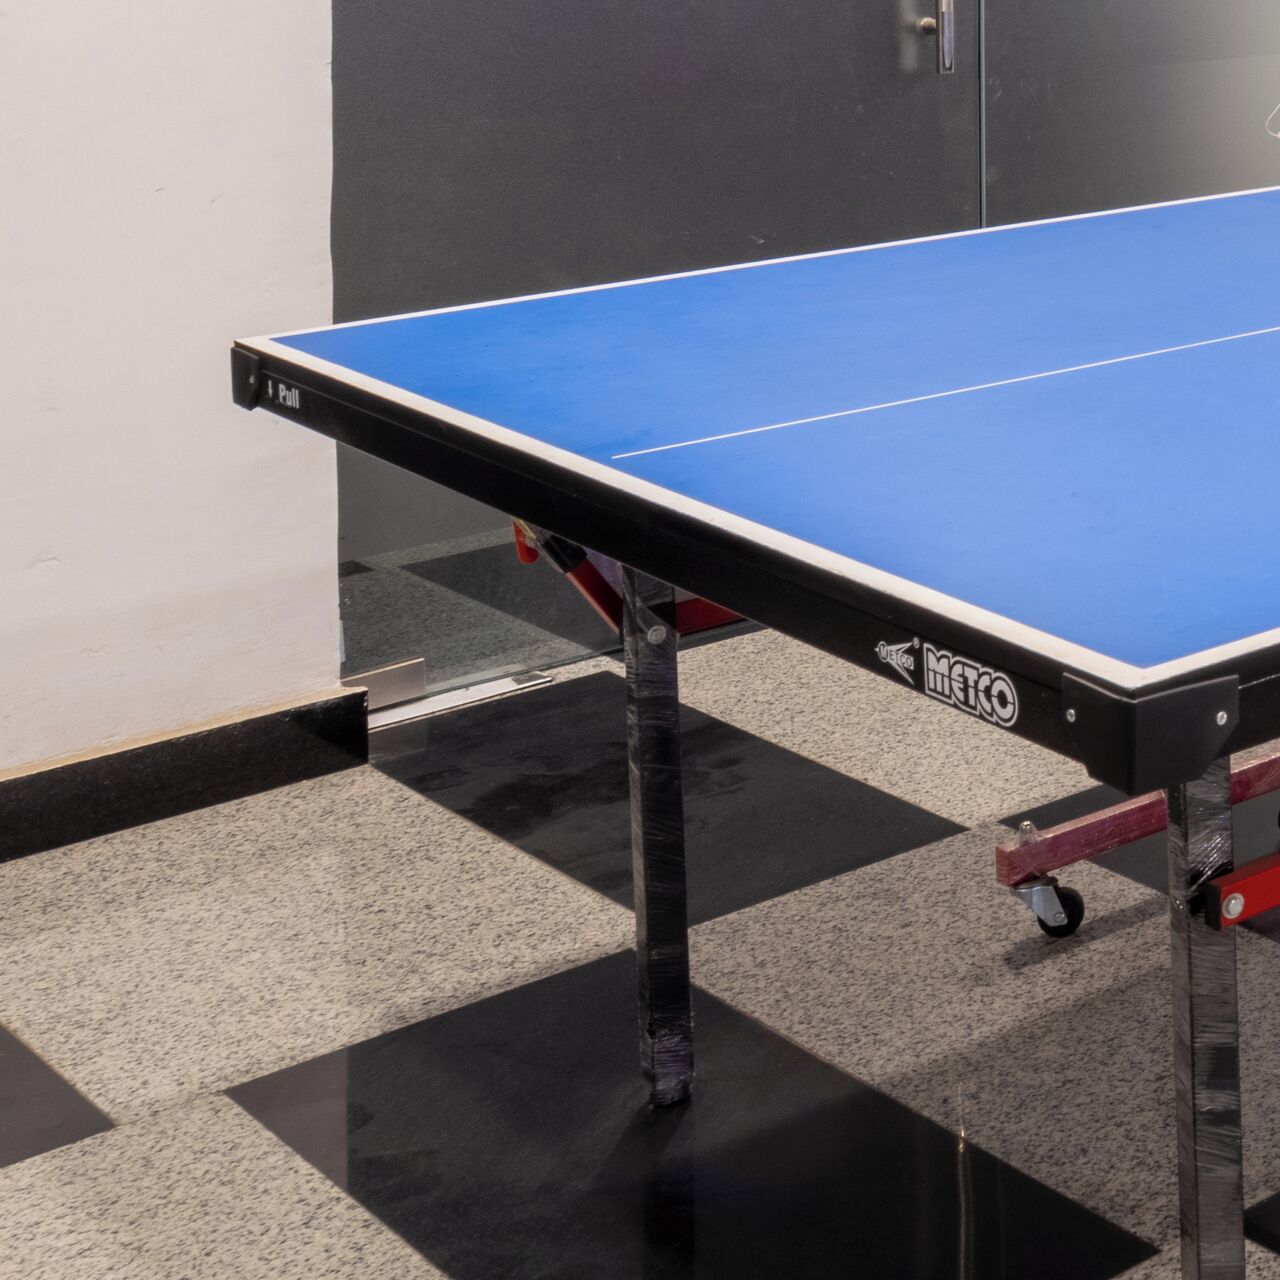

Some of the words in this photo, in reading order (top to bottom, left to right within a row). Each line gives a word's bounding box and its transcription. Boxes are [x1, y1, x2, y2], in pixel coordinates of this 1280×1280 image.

[278, 382, 299, 409] Pull
[878, 641, 914, 670] METCO
[924, 643, 1018, 727] METCO
